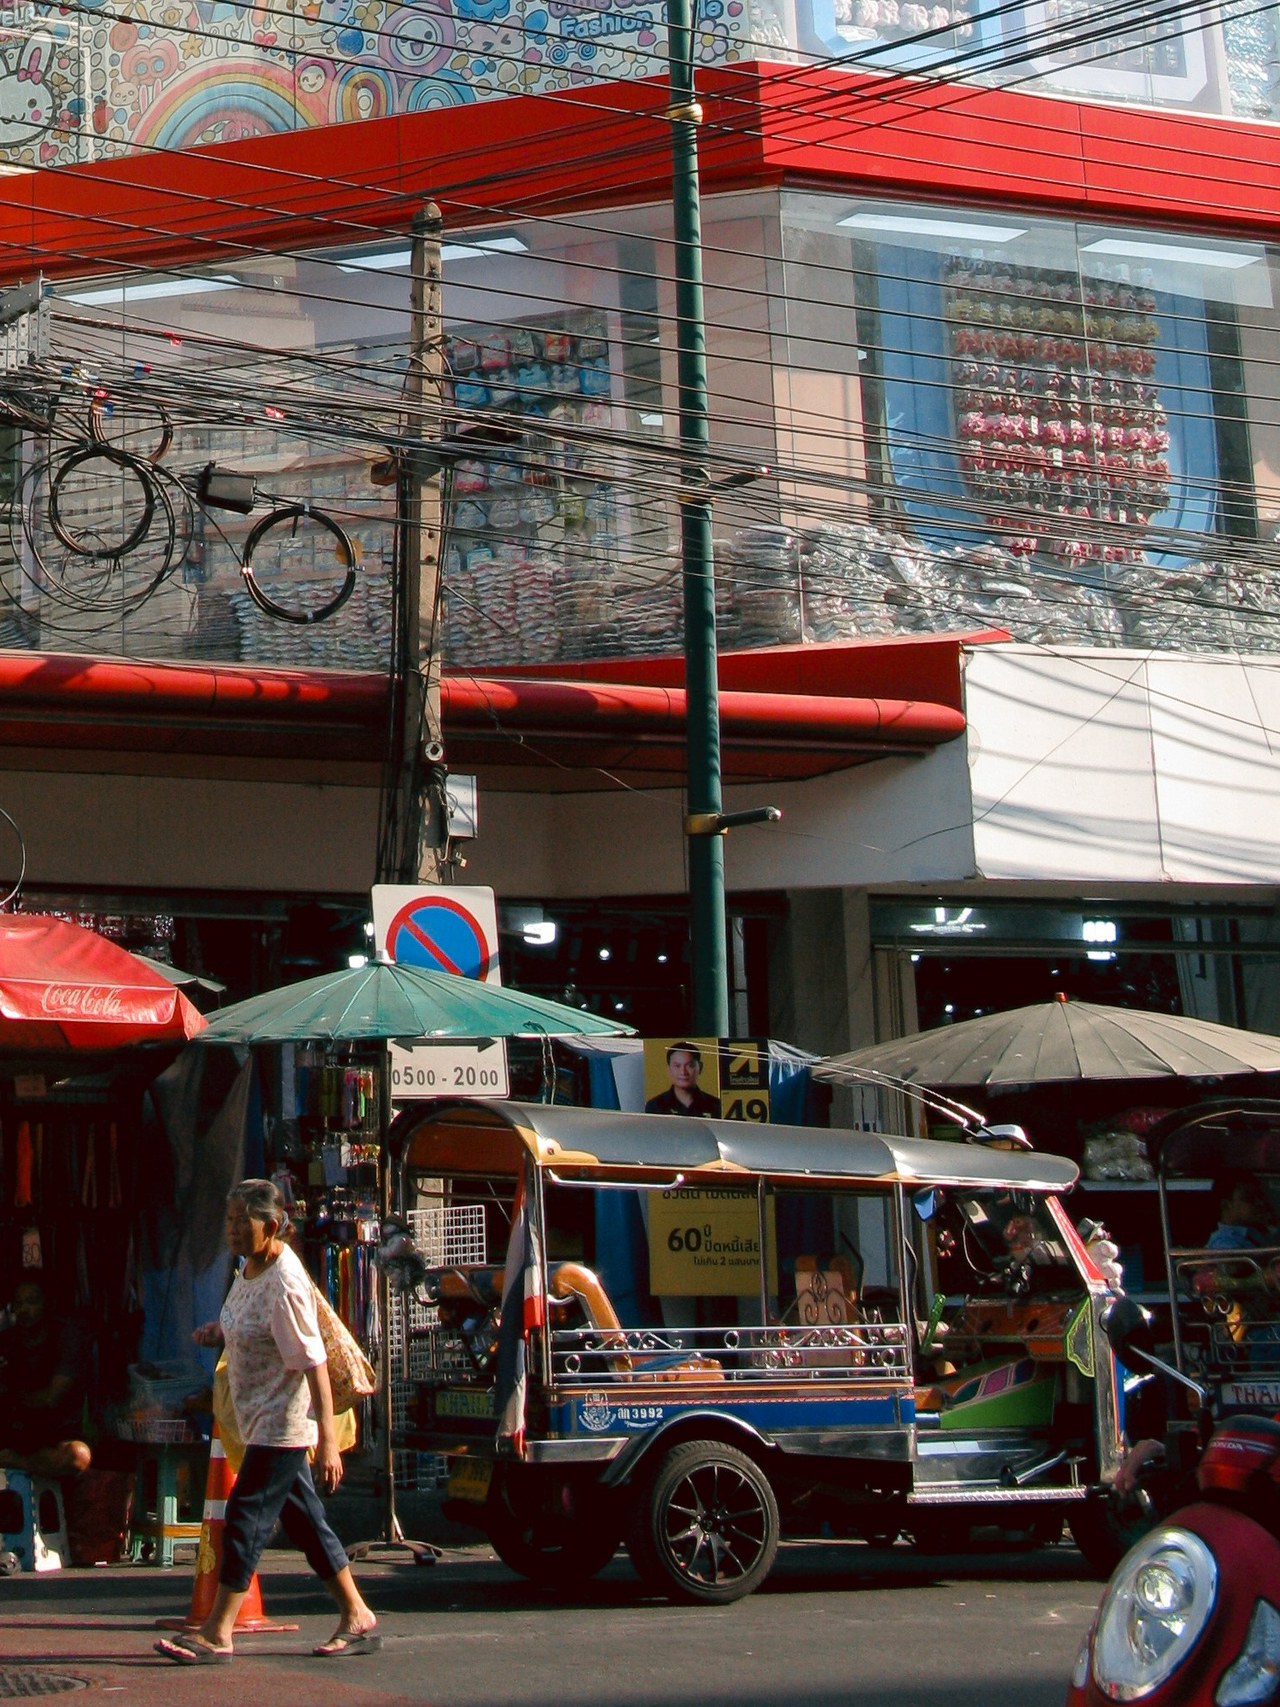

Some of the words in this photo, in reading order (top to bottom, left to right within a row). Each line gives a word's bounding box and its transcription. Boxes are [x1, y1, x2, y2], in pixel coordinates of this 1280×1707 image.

[560, 10, 655, 42] Fashion
[722, 1098, 768, 1125] 49
[667, 1227, 702, 1253] 60
[703, 1224, 712, 1237] ปี
[720, 1256, 727, 1266] 2
[632, 1407, 664, 1420] 3992
